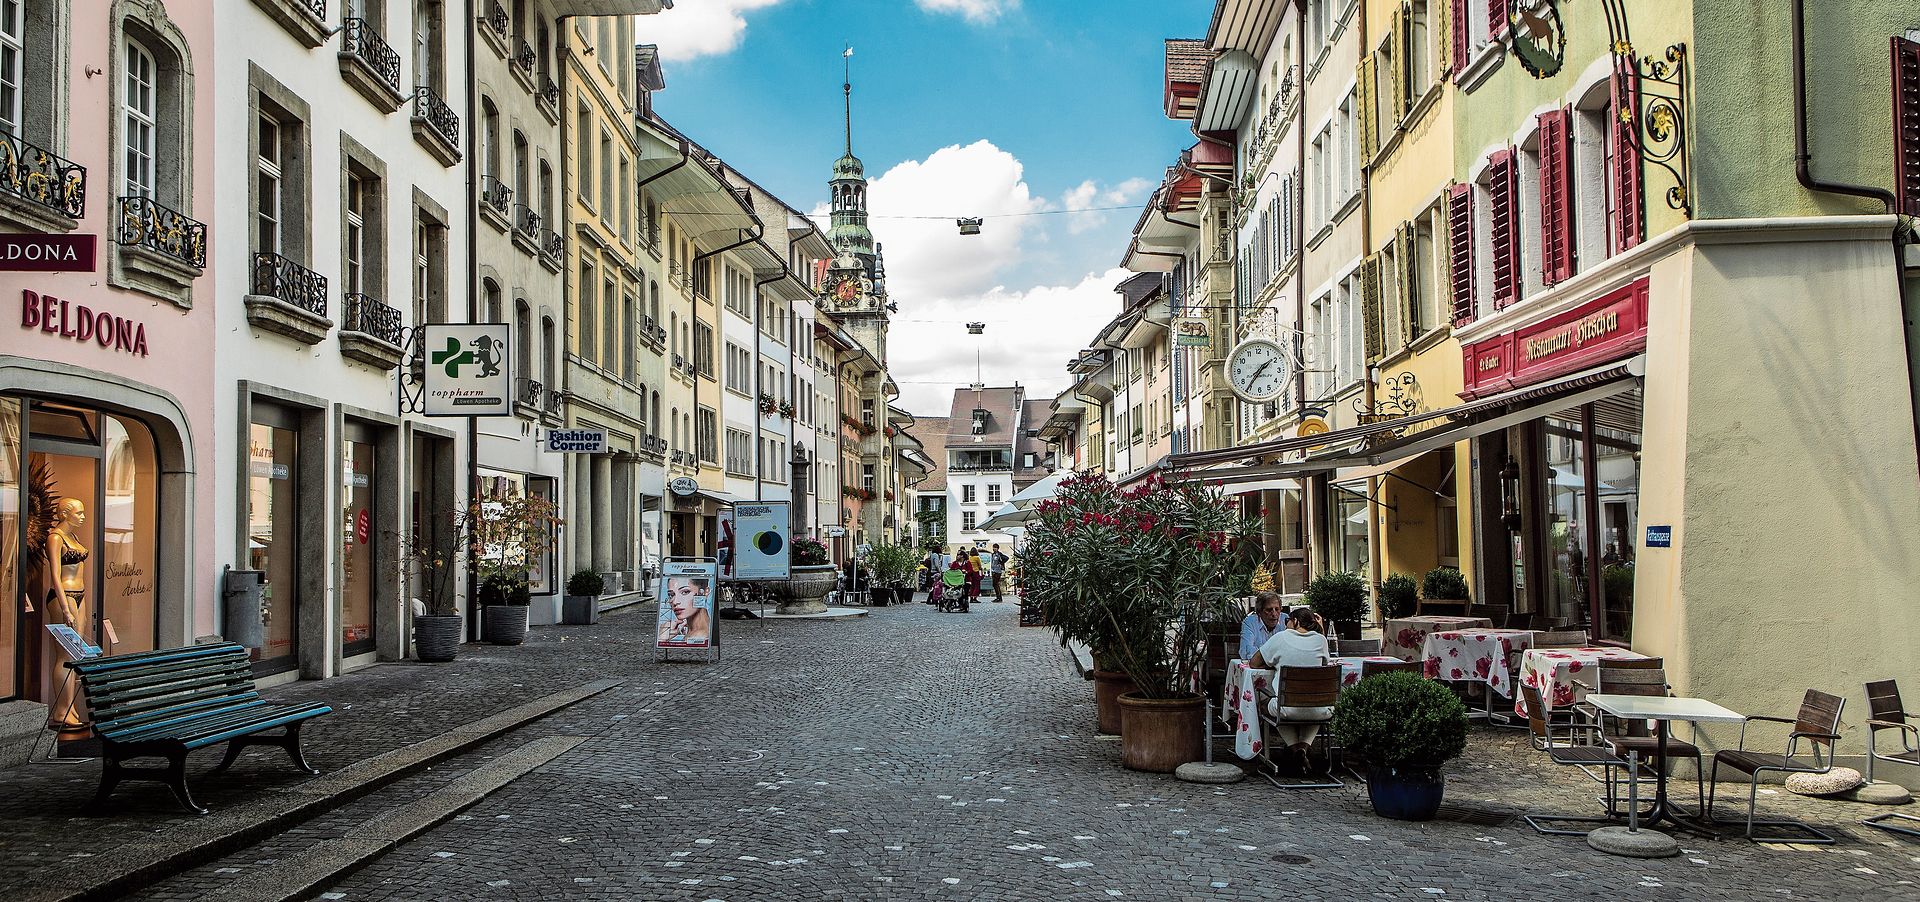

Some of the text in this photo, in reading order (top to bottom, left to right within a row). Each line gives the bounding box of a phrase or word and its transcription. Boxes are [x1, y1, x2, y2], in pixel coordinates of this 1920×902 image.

[0, 244, 78, 260] DONA
[22, 289, 149, 356] BELDONA
[1526, 308, 1617, 362] Restaurant Hirschen
[431, 387, 484, 399] toppharm
[549, 430, 602, 442] Fashion
[550, 440, 600, 451] Corner
